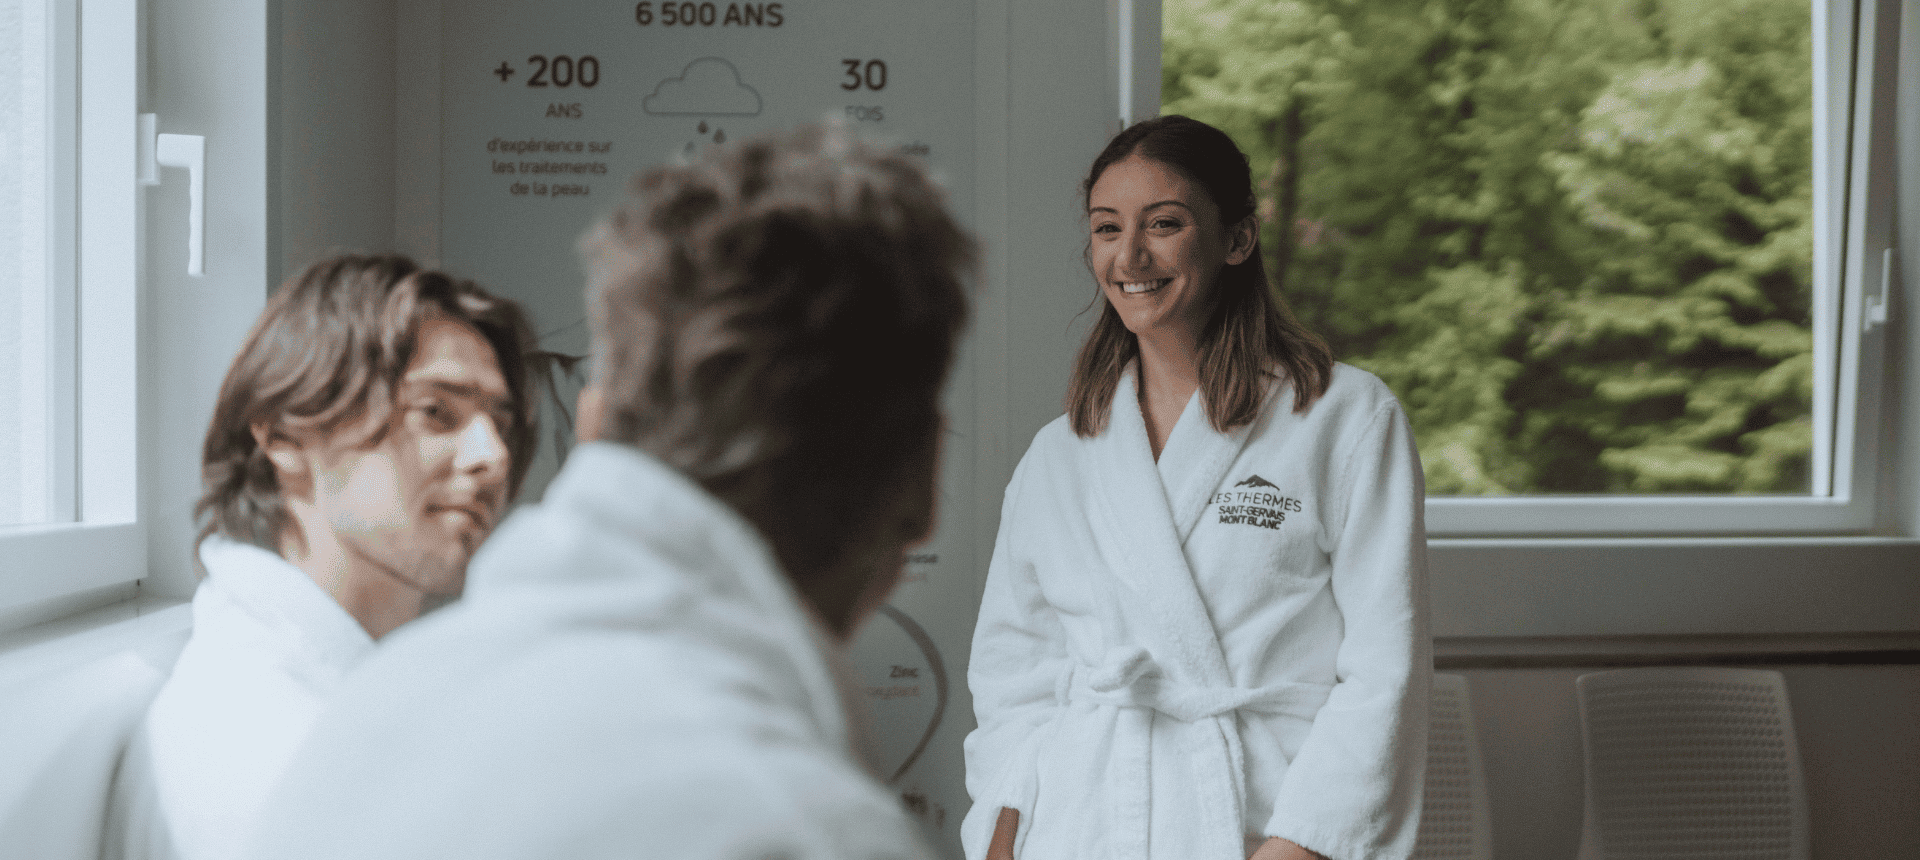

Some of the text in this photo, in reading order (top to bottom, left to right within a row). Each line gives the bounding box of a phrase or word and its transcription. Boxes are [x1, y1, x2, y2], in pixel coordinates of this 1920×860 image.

[635, 1, 784, 28] 6 500 ANS
[527, 54, 600, 88] 200
[841, 58, 887, 91] 30
[545, 102, 583, 119] ANS
[844, 104, 884, 121] FOIS
[486, 138, 612, 155] d'expérience sur
[492, 160, 608, 174] les traitements
[510, 182, 590, 198] de la peau
[1235, 491, 1302, 513] THERMES
[1218, 505, 1286, 522] SAINT-GERVAIS
[1218, 515, 1282, 530] MONT BLANC
[889, 664, 919, 679] Zinc
